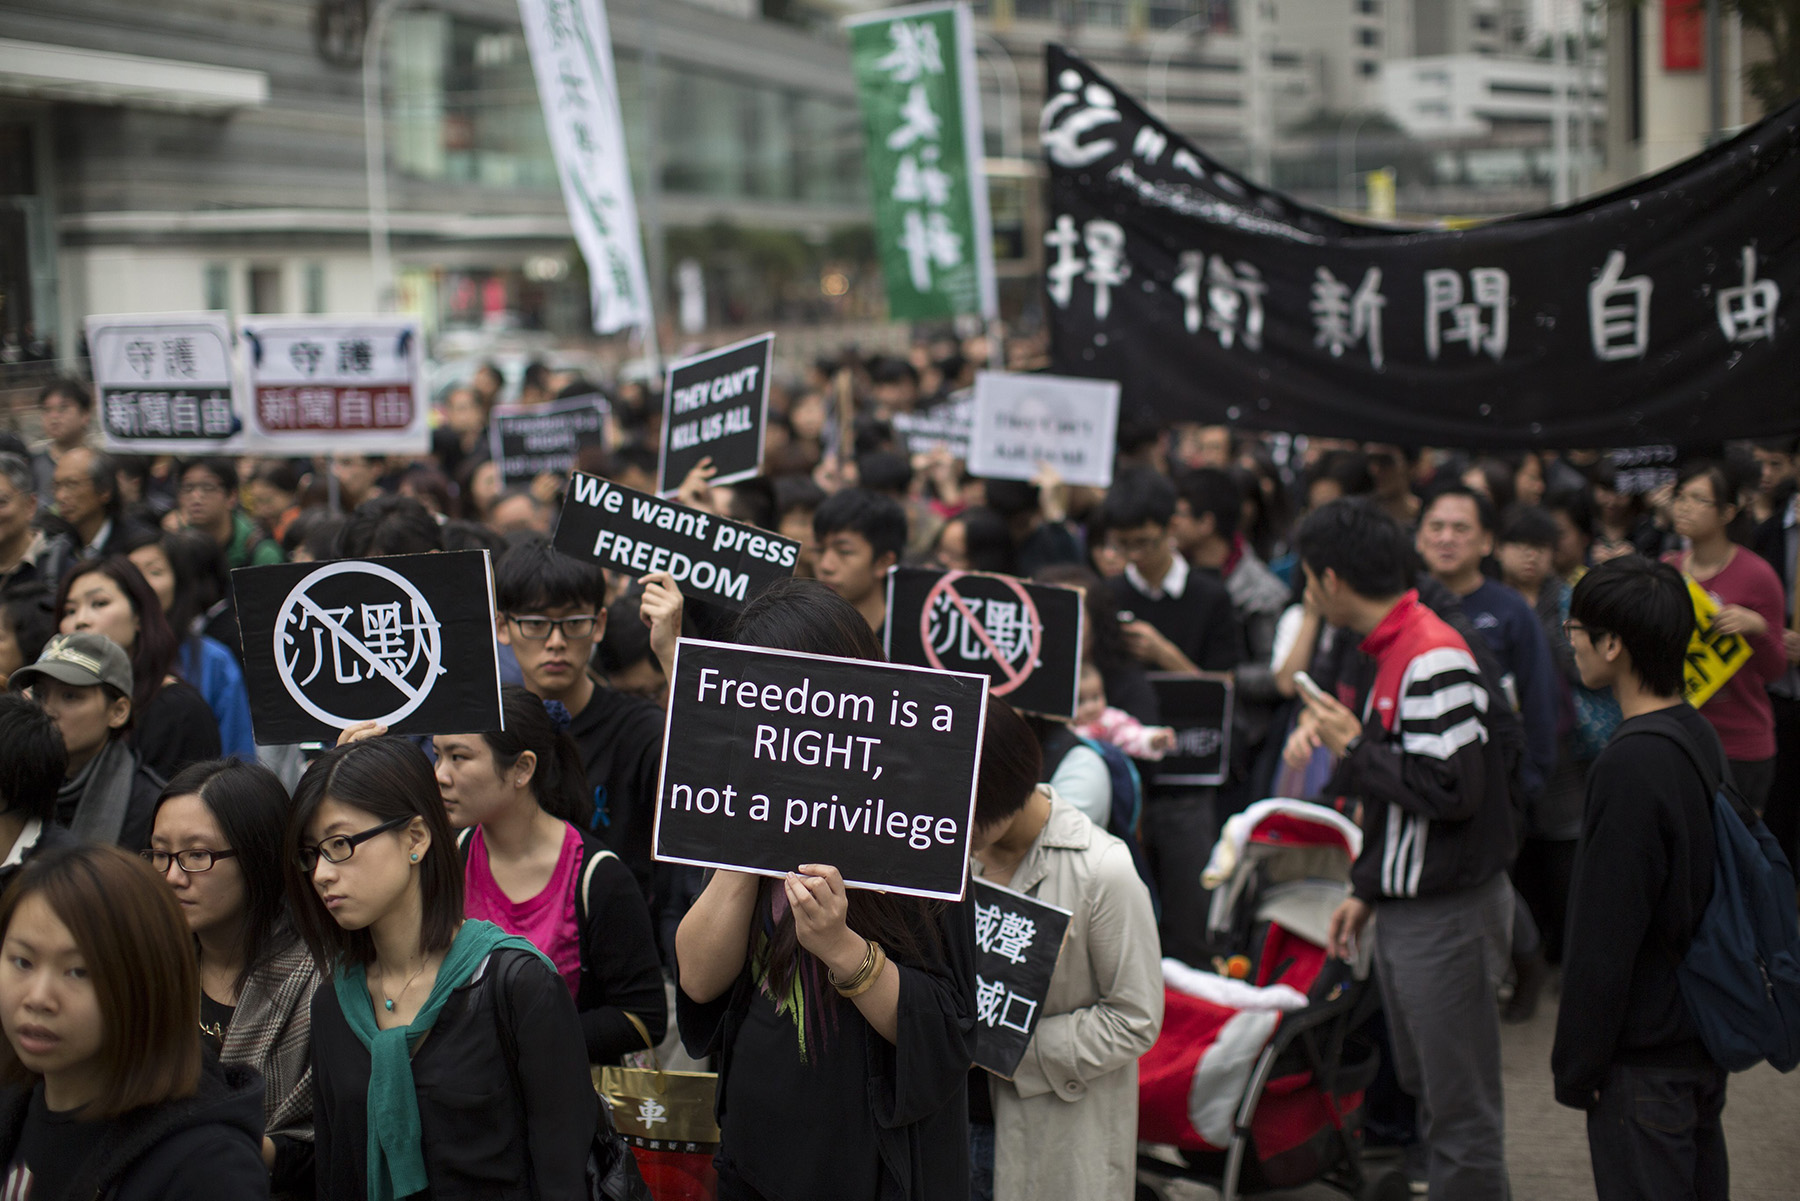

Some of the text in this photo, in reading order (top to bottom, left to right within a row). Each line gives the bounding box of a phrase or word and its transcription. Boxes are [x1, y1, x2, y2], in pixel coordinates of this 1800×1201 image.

[125, 336, 198, 379] 守護
[288, 338, 374, 377] 守護
[104, 390, 232, 437] 新聞自由
[261, 386, 412, 430] 新聞自由
[673, 381, 711, 414] THEY
[670, 405, 753, 452] KILL US ALL
[574, 473, 798, 568] We want press
[592, 529, 750, 602] FREEDOM
[281, 599, 448, 687] 沉默
[929, 594, 1045, 669] 沉默
[697, 667, 954, 733] Freedom is a
[753, 724, 884, 781] RIGHT,
[670, 783, 958, 851] not a privilege
